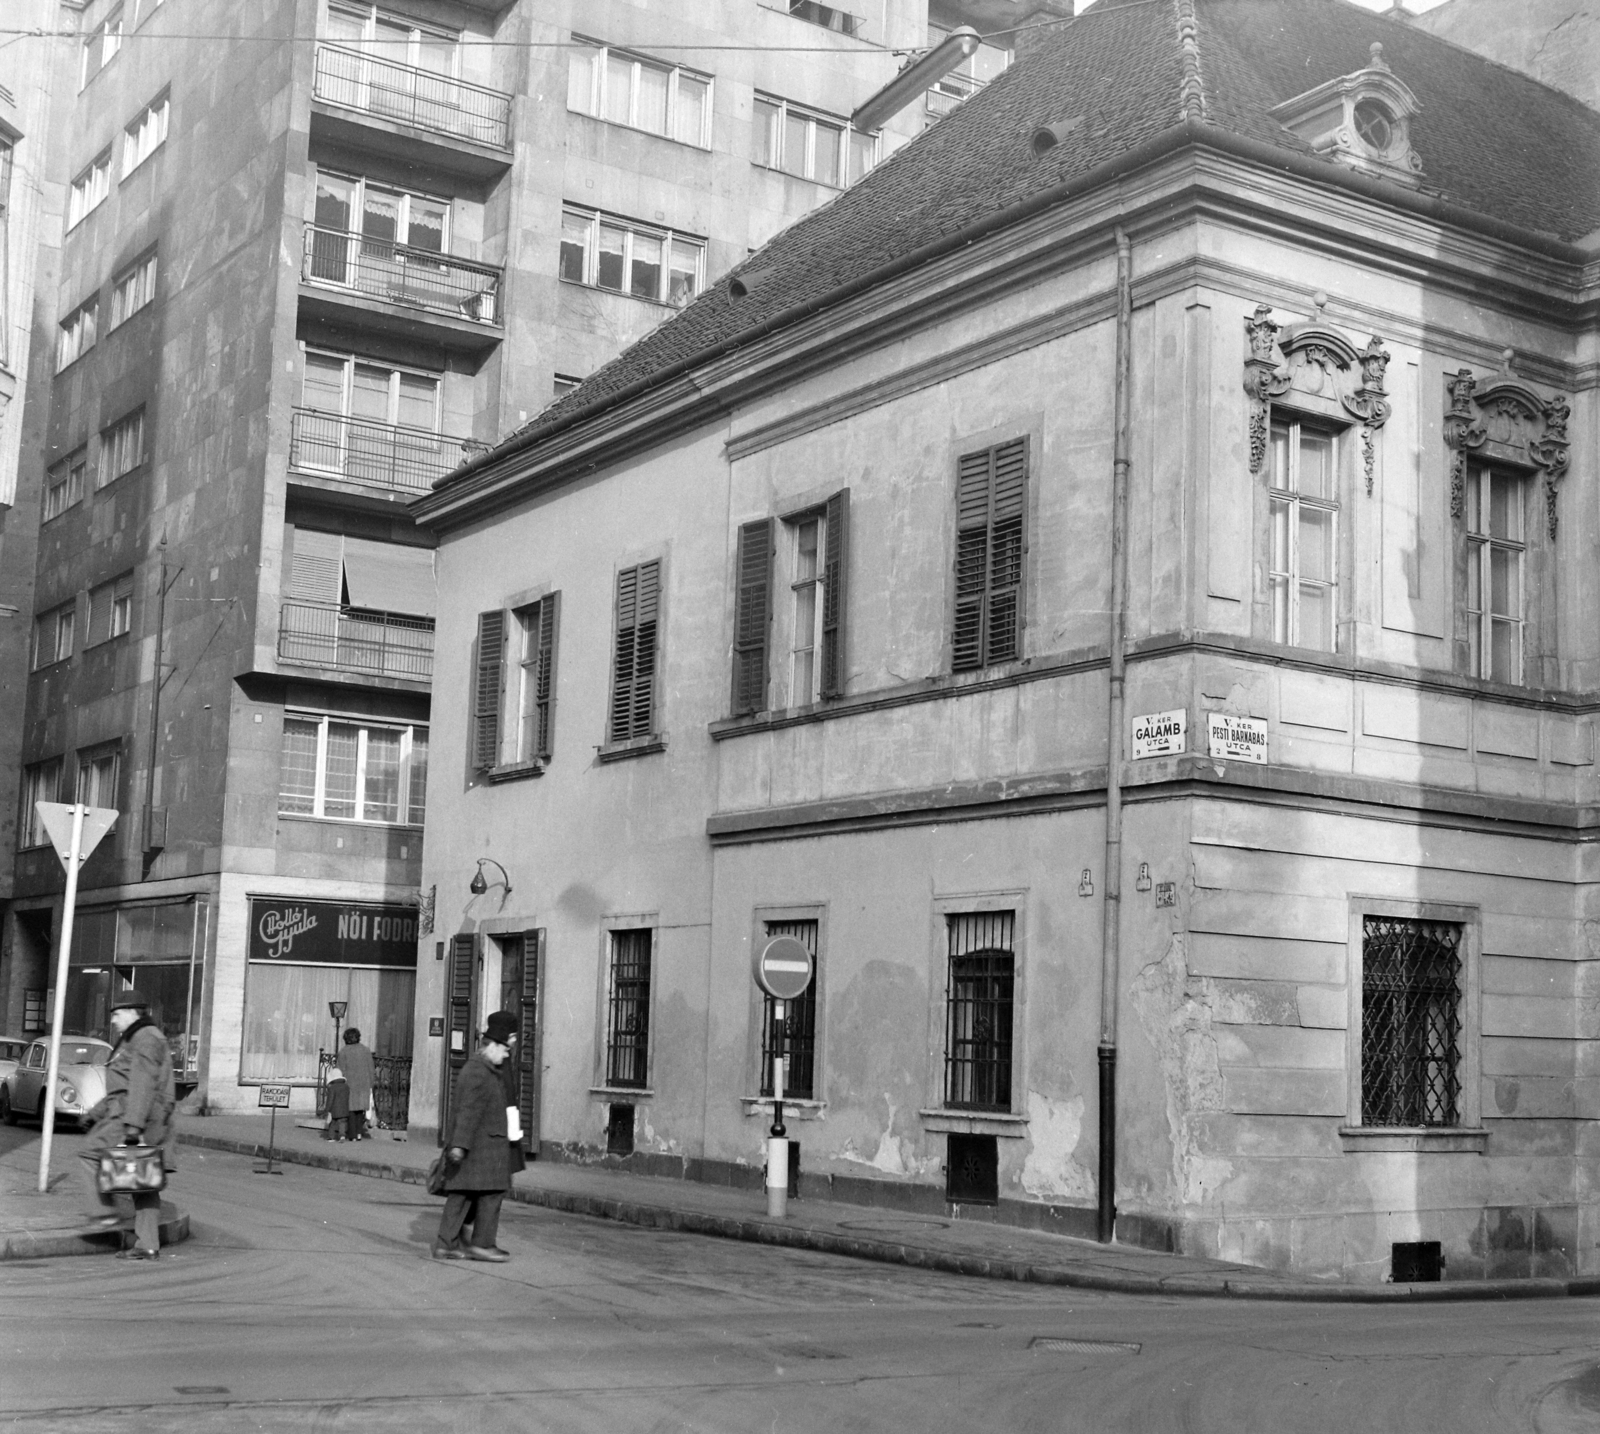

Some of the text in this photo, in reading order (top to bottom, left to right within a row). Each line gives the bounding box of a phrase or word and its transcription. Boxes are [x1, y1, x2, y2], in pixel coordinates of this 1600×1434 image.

[1136, 722, 1181, 740] GALAMB
[1212, 726, 1229, 741] PESTI
[1146, 737, 1170, 747] UTCA
[1226, 742, 1252, 751] UTCA
[259, 908, 319, 958] Gyula
